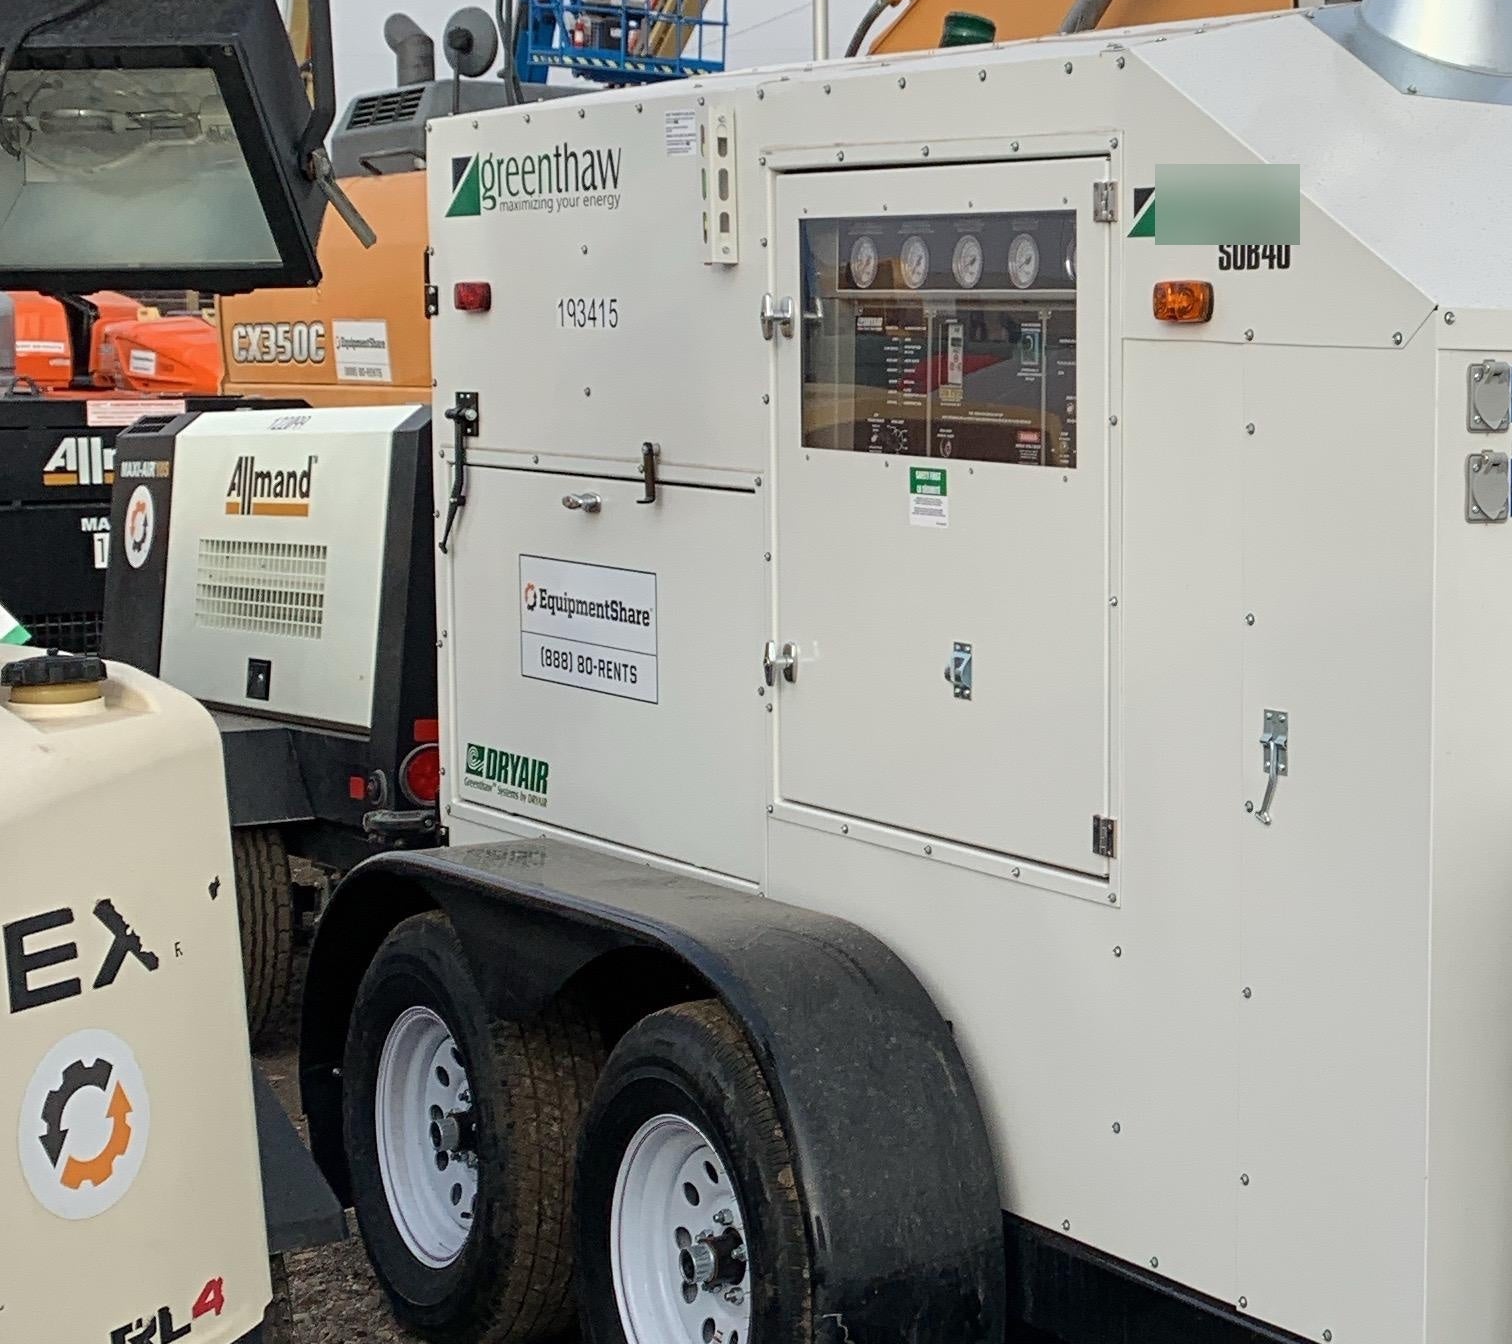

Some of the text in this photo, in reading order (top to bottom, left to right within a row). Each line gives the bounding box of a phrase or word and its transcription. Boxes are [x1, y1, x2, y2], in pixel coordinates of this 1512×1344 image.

[481, 142, 621, 210] greenthaw
[499, 193, 621, 213] maximizing your energy
[557, 297, 619, 329] 193415
[232, 320, 326, 364] CX350C
[227, 456, 311, 515] Allmand
[538, 588, 650, 627] EquipmentShare
[540, 646, 638, 685] (888) 80-RENTS
[486, 748, 549, 794] DRYAIR
